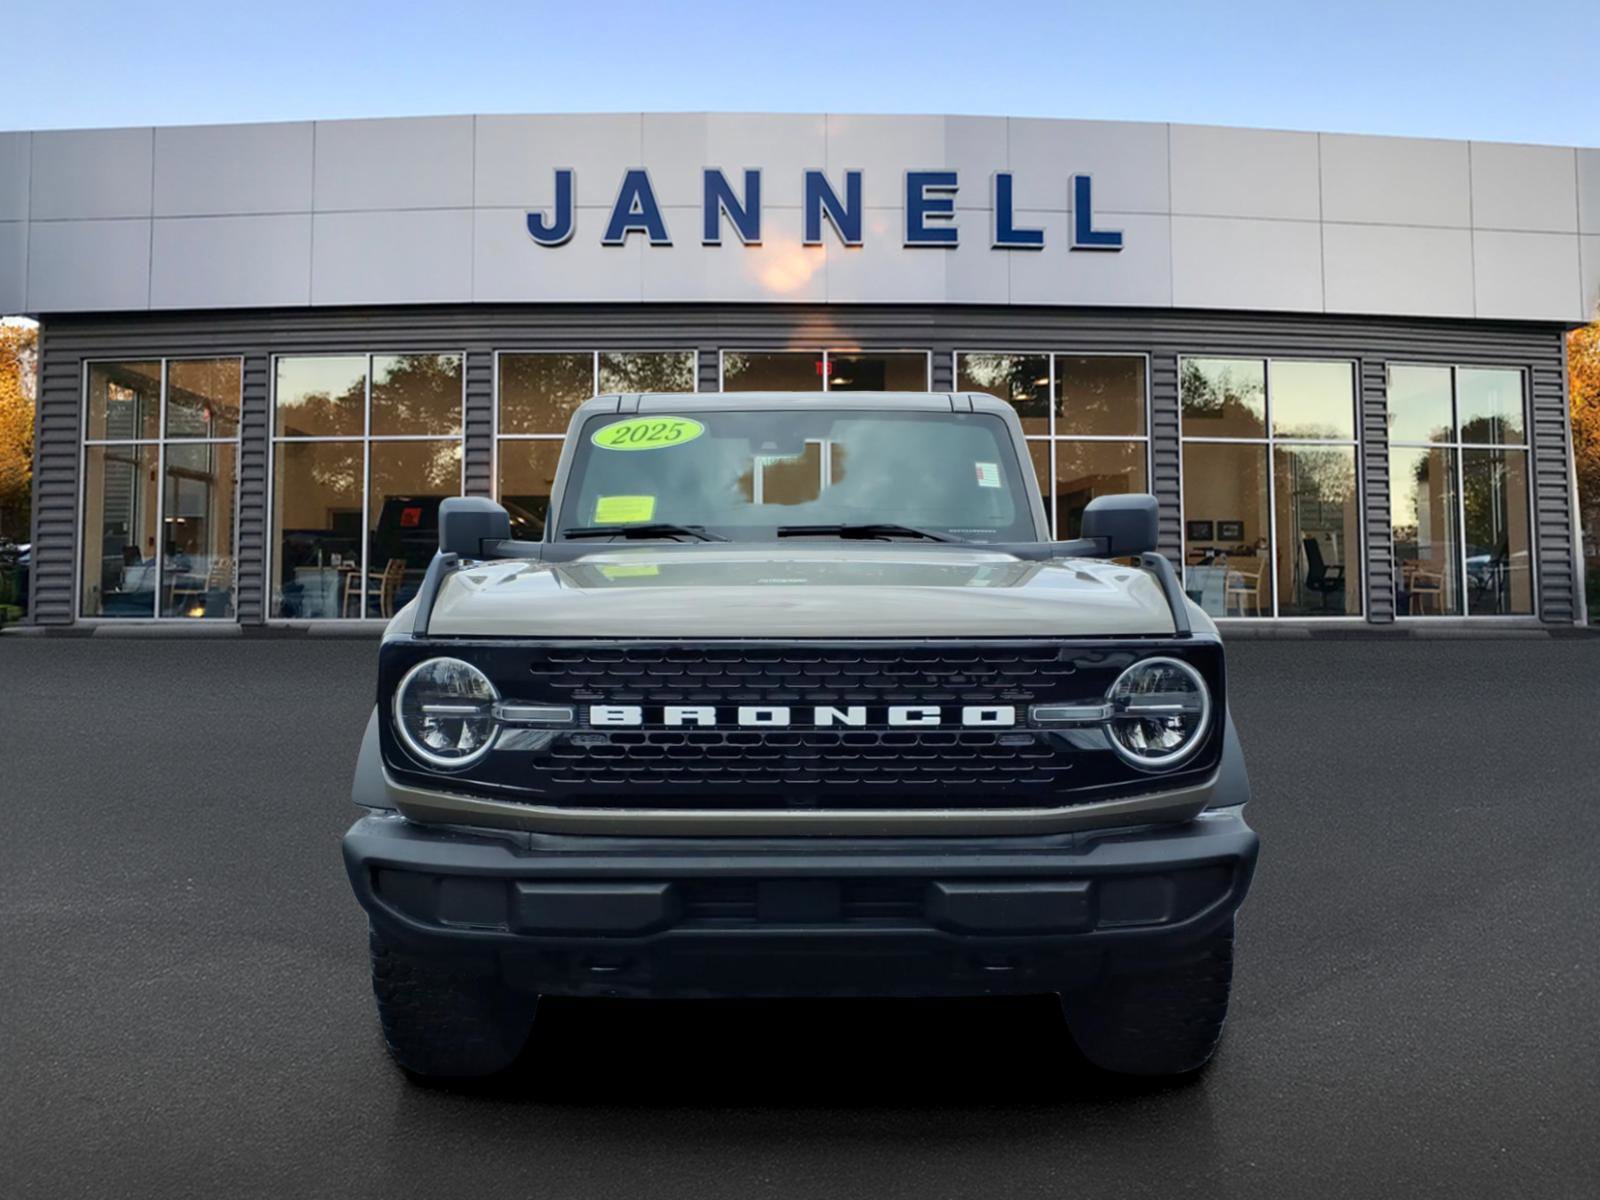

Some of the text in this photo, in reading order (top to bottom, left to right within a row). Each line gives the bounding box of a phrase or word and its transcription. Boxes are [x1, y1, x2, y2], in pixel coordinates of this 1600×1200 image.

[526, 167, 1124, 250] JANNELL
[610, 423, 686, 445] 2025
[590, 705, 1016, 727] BRONCO
